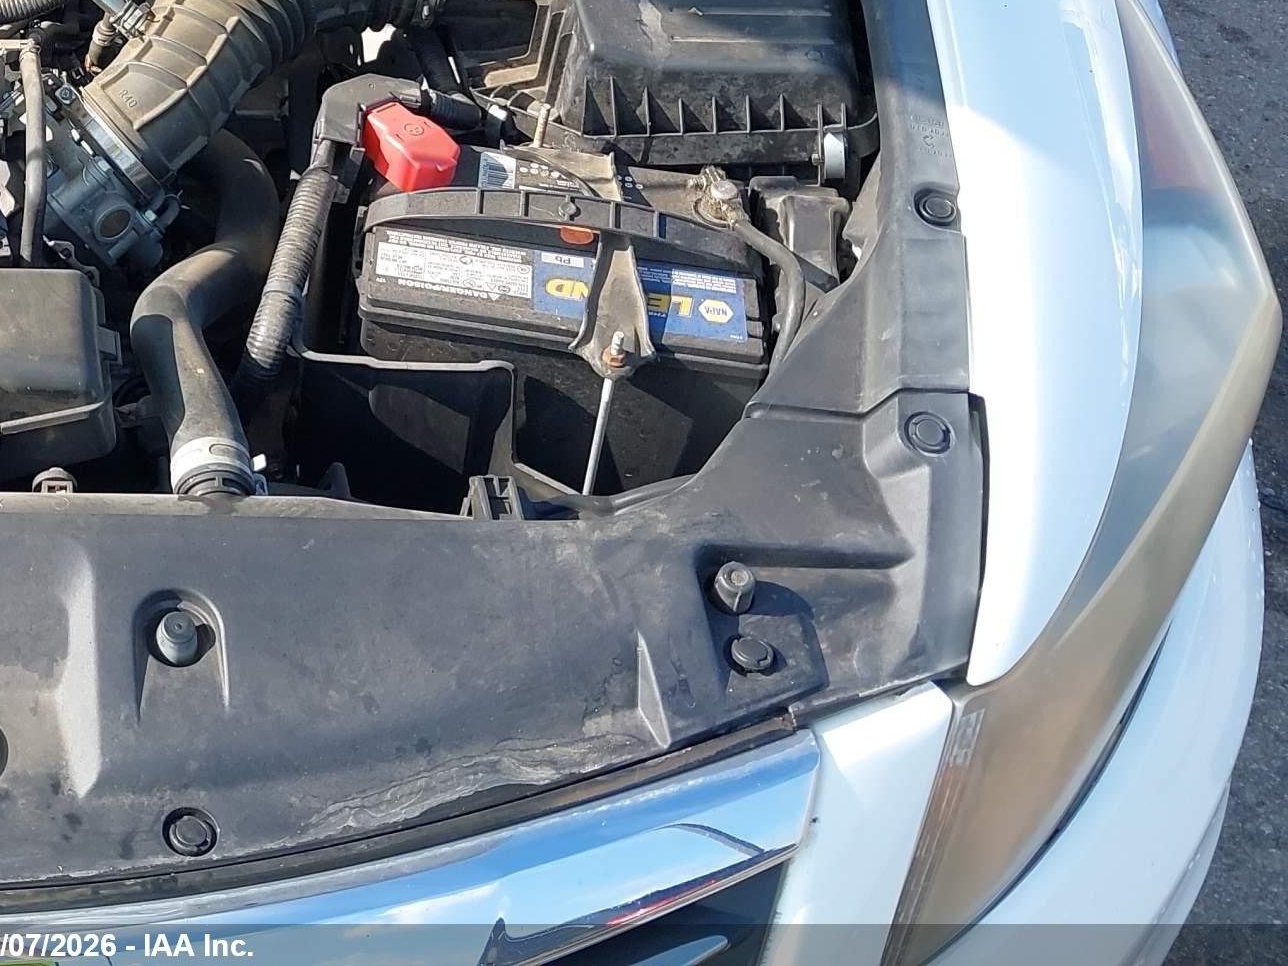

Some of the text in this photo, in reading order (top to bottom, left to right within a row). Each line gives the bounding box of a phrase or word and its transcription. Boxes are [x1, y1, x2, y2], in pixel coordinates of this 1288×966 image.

[119, 89, 138, 108] R40
[554, 255, 571, 265] Pb
[704, 305, 728, 317] NAPA
